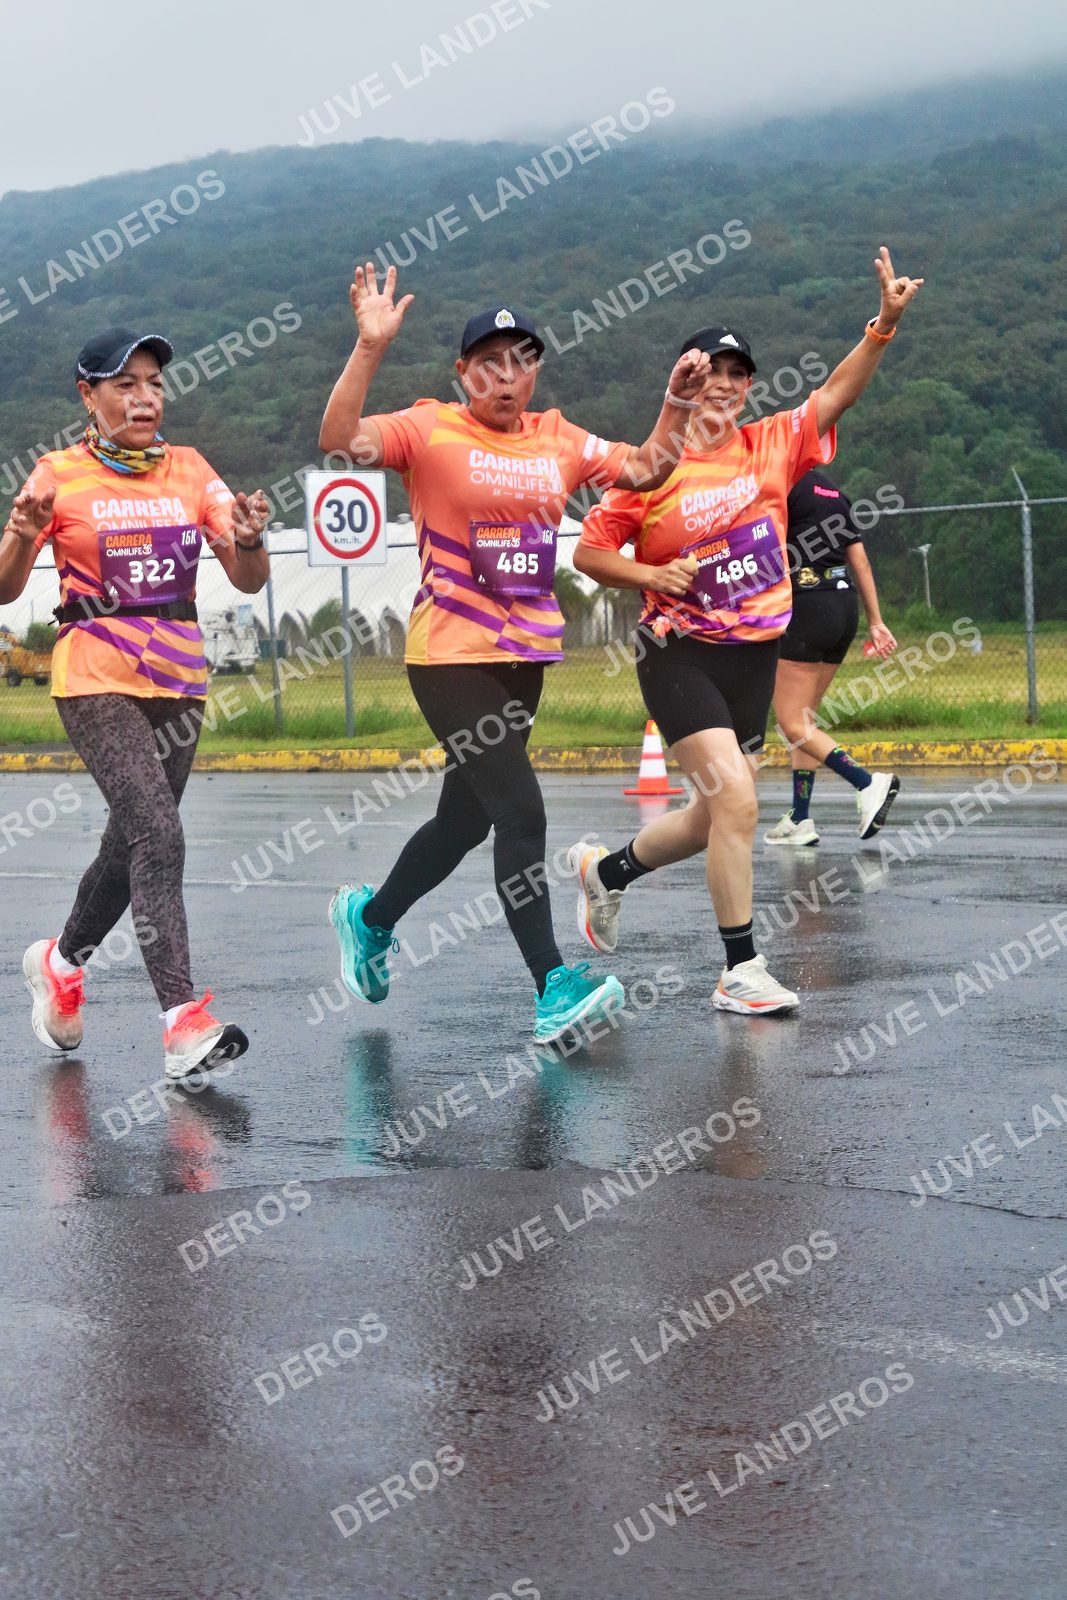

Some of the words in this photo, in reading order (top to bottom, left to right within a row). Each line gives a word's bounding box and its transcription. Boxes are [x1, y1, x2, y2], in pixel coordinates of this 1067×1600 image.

[470, 448, 560, 479] CARRERA
[470, 470, 548, 493] OMNILIFE
[681, 472, 758, 517] CARRERA
[92, 498, 186, 519] CARRERA
[326, 499, 368, 534] 30
[106, 534, 152, 548] CARRERA
[476, 539, 511, 548] OMNILIFE
[477, 528, 520, 539] CARRERA
[107, 548, 142, 557] OMNILIFE
[691, 538, 730, 558] ARRERA
[128, 558, 176, 583] 322
[496, 552, 539, 575] 485
[697, 552, 724, 568] MNILIFE
[716, 554, 758, 584] 486
